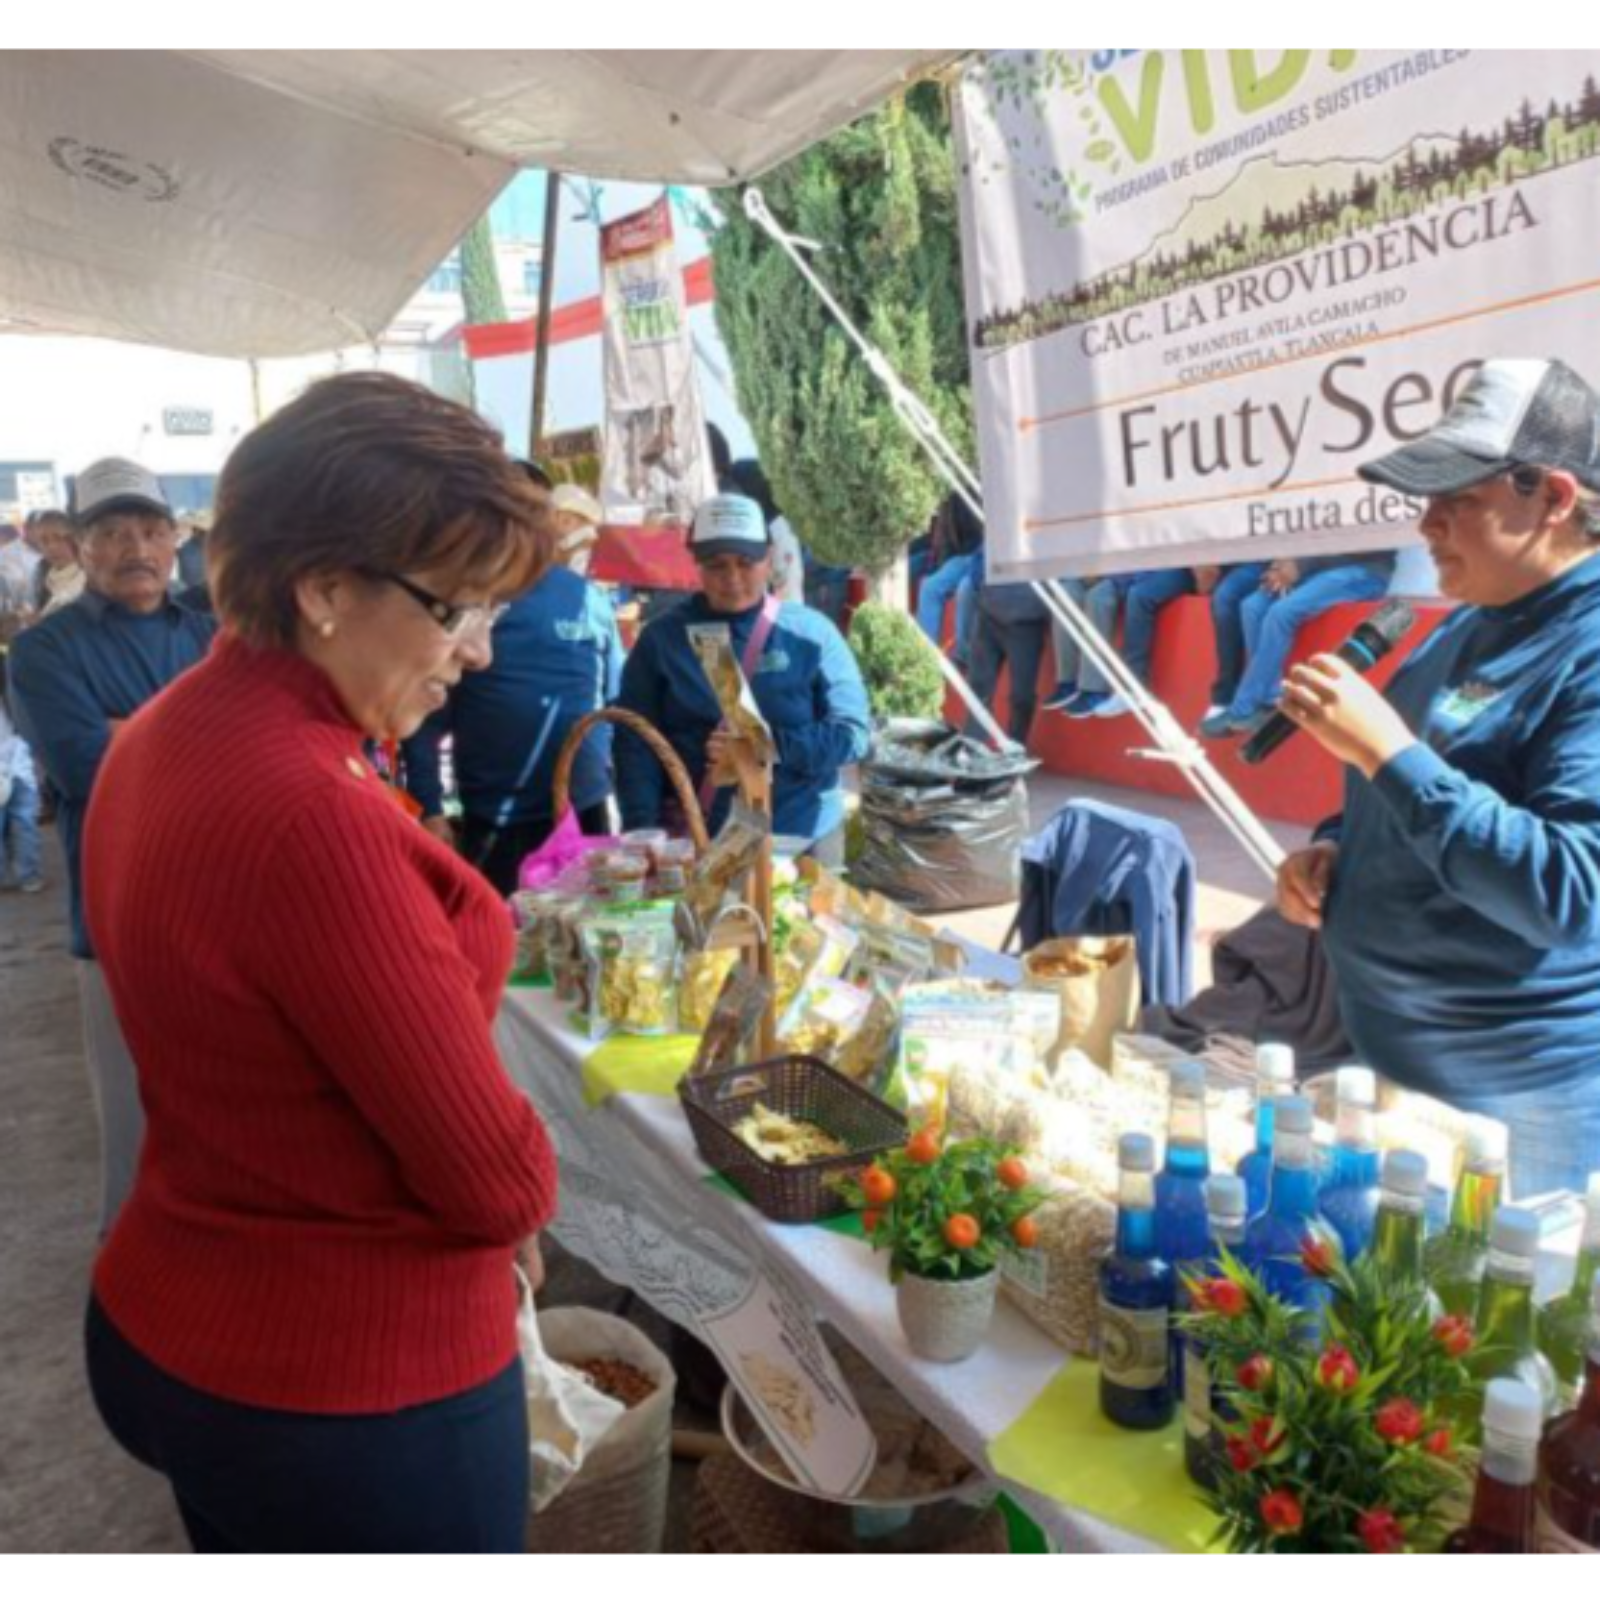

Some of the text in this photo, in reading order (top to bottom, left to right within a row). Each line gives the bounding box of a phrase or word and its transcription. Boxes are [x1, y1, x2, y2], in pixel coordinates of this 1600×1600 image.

[1095, 166, 1169, 213] PROGRAMA
[1170, 155, 1192, 182] DE
[1194, 102, 1310, 171] COMUNIDADES
[1098, 48, 1356, 163] VID
[1080, 190, 1538, 358] CAC. LA PROVIDENCIA
[1163, 347, 1180, 366] DE
[1187, 329, 1255, 361] MANUEL
[1307, 286, 1407, 324] CAMACHO
[1247, 485, 1423, 537] Fruta des
